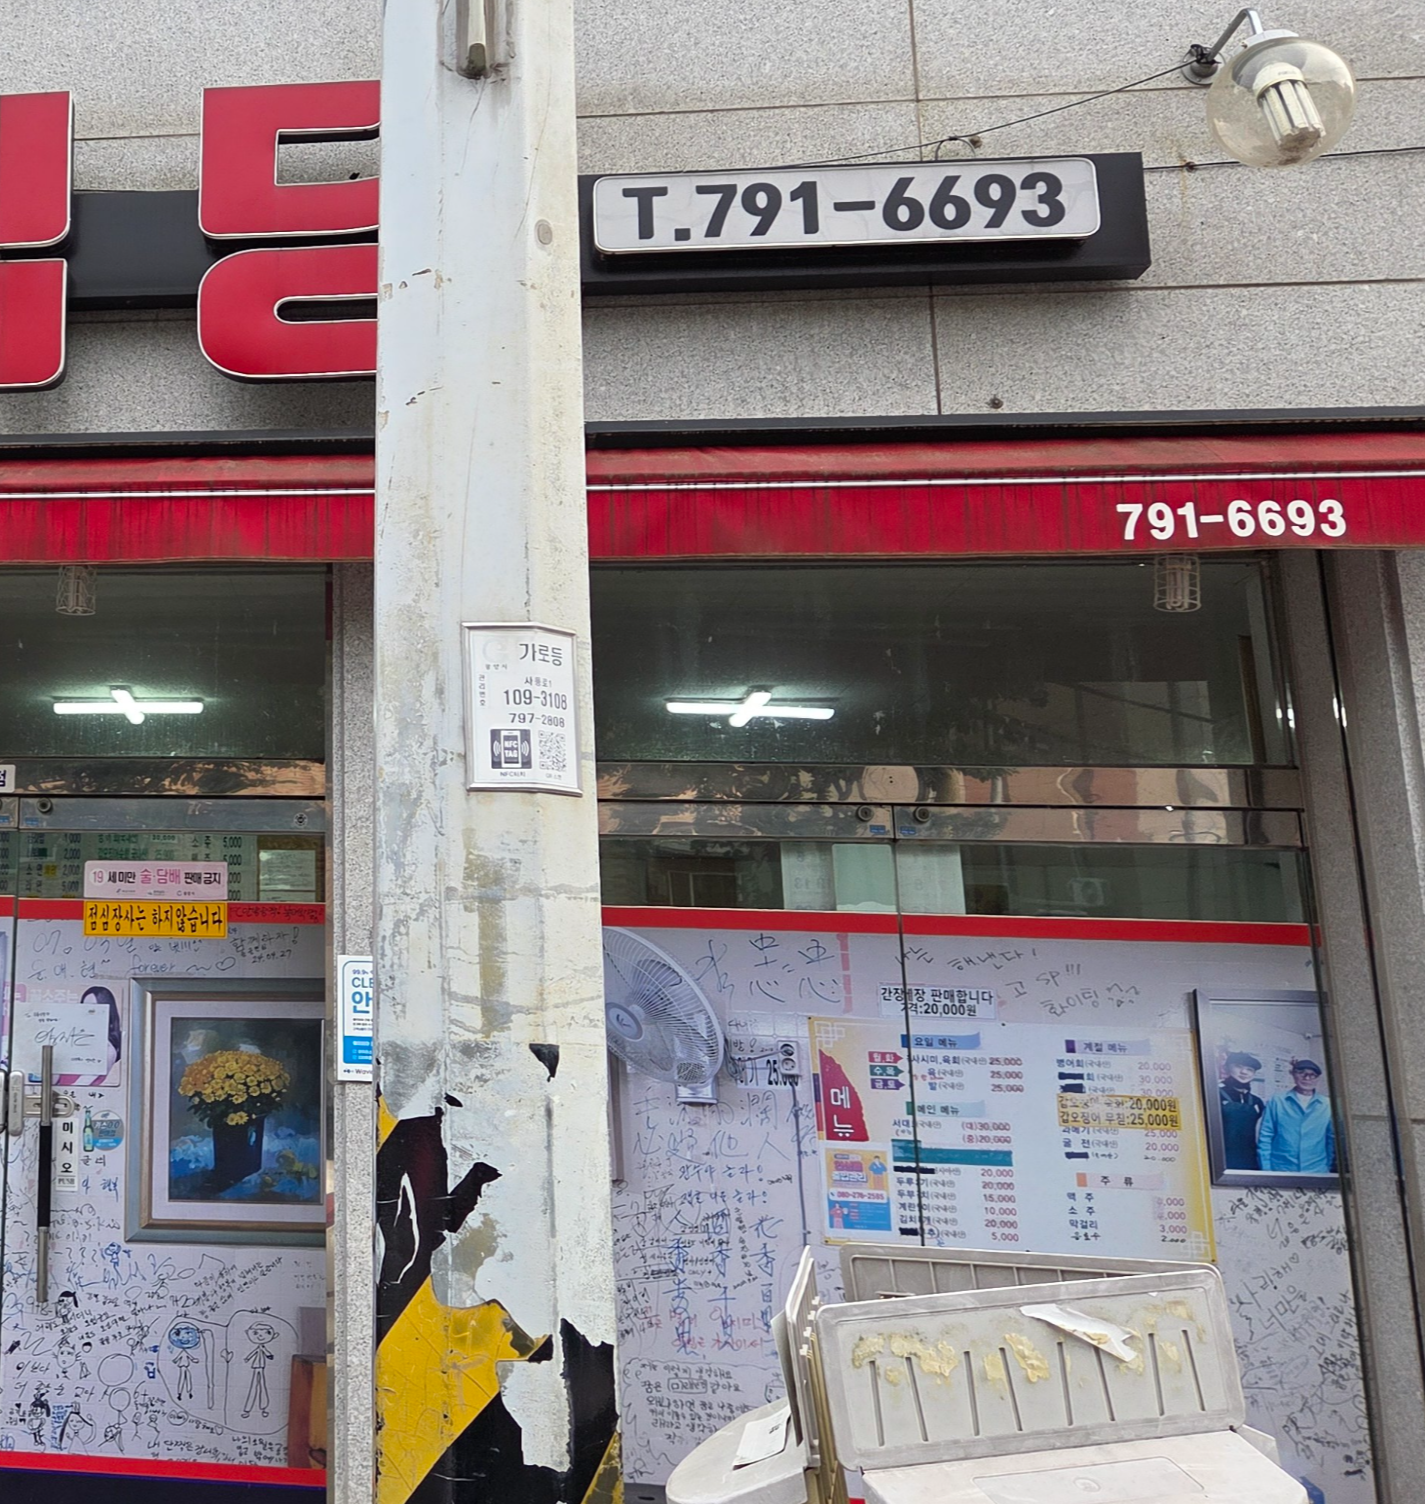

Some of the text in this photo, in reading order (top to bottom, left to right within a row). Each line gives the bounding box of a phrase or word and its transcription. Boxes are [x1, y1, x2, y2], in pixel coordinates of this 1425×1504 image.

[622, 172, 1067, 242] T.791-6693
[1116, 499, 1347, 541] 791-6693
[519, 643, 563, 667] 가로등
[503, 688, 568, 710] 109-3108
[508, 712, 566, 728] 797-2808
[223, 836, 242, 849] 5,000
[93, 870, 104, 883] 19
[108, 871, 136, 884] 세미만
[140, 868, 181, 885] 술·담배
[88, 903, 147, 932] 점심장사는
[152, 904, 224, 934] 하지않습니다
[930, 989, 994, 1006] 판매합니다
[938, 1037, 957, 1048] 메뉴
[988, 1057, 1023, 1066] 25,000
[1138, 1062, 1172, 1071] 20,000
[990, 1071, 1023, 1080] 25,000
[1138, 1075, 1173, 1084] 30,000
[991, 1084, 1024, 1093] 25,000
[940, 1105, 960, 1116] 메뉴
[1059, 1111, 1179, 1127] 갑오징어 무침:25,000원
[1144, 1130, 1179, 1139] 25,000
[61, 1121, 74, 1173] 미시오
[1145, 1142, 1180, 1152] 20,000
[980, 1168, 1013, 1178] 20,000
[982, 1181, 1015, 1191] 20,000
[983, 1194, 1016, 1204] 15,000
[984, 1206, 1017, 1216] 10,000
[985, 1219, 1018, 1229] 20,000
[1069, 1219, 1188, 1235] 막걸리 3,000
[991, 1232, 1019, 1242] 5,000
